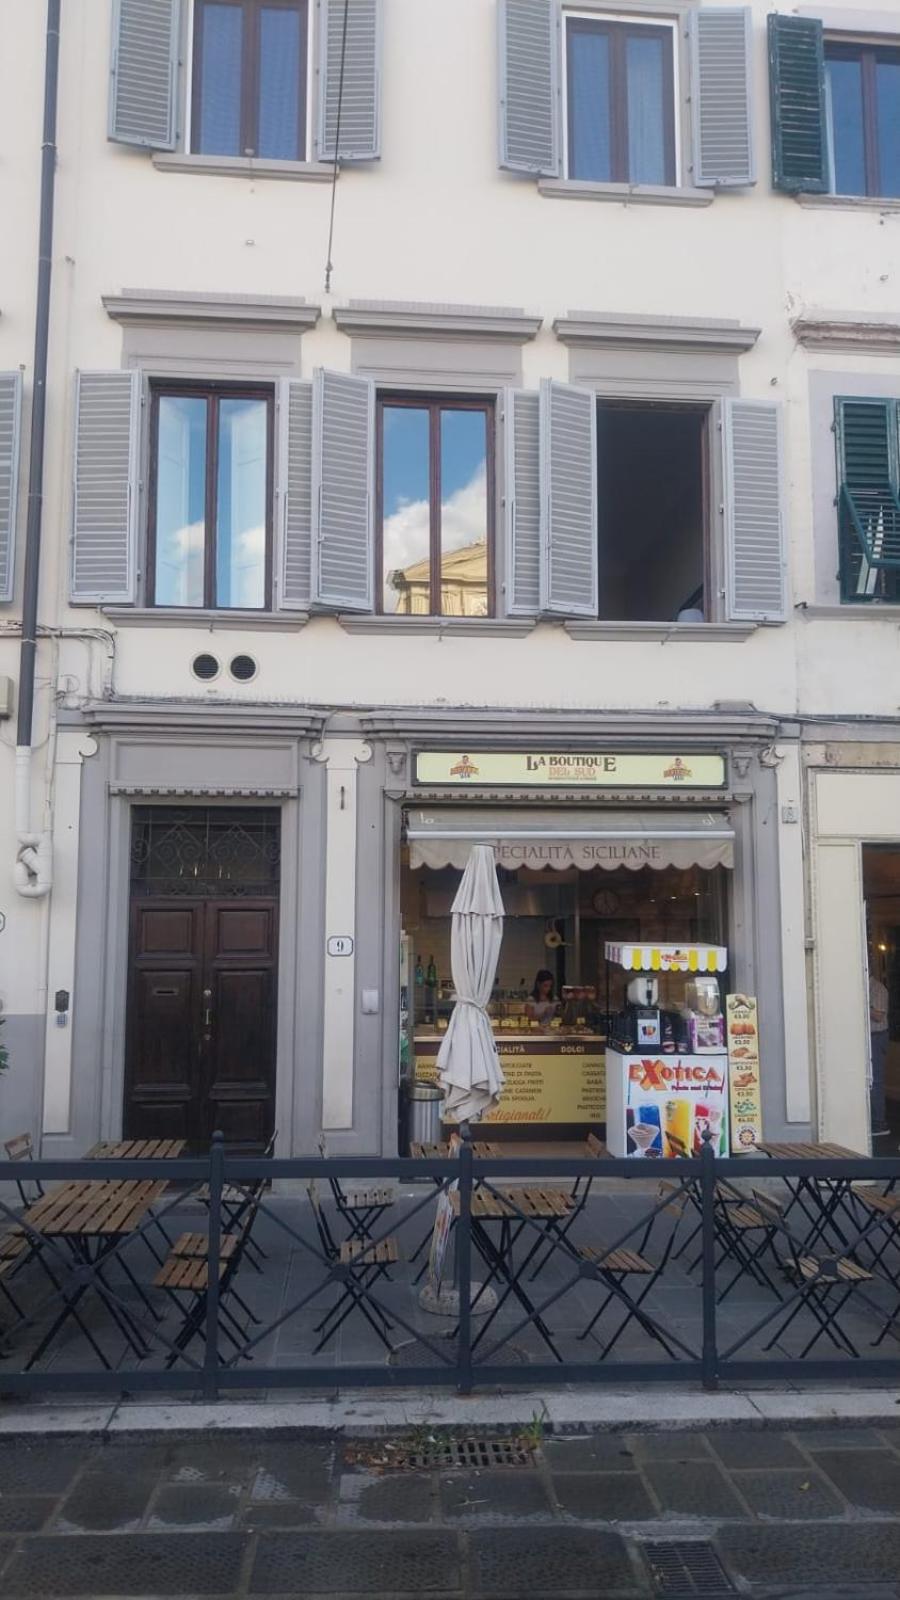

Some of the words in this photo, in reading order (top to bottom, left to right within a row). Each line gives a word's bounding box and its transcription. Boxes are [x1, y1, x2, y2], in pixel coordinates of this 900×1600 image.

[526, 756, 546, 771] LA
[549, 756, 616, 772] BOUTIQUE
[549, 766, 570, 776] DEL
[575, 767, 596, 777] SUD
[493, 844, 574, 860] PECIALITÀ
[582, 845, 661, 860] SICILIANE
[336, 940, 344, 952] 9
[496, 1045, 526, 1053] CIALITÀ
[560, 1046, 585, 1054] DOLCI
